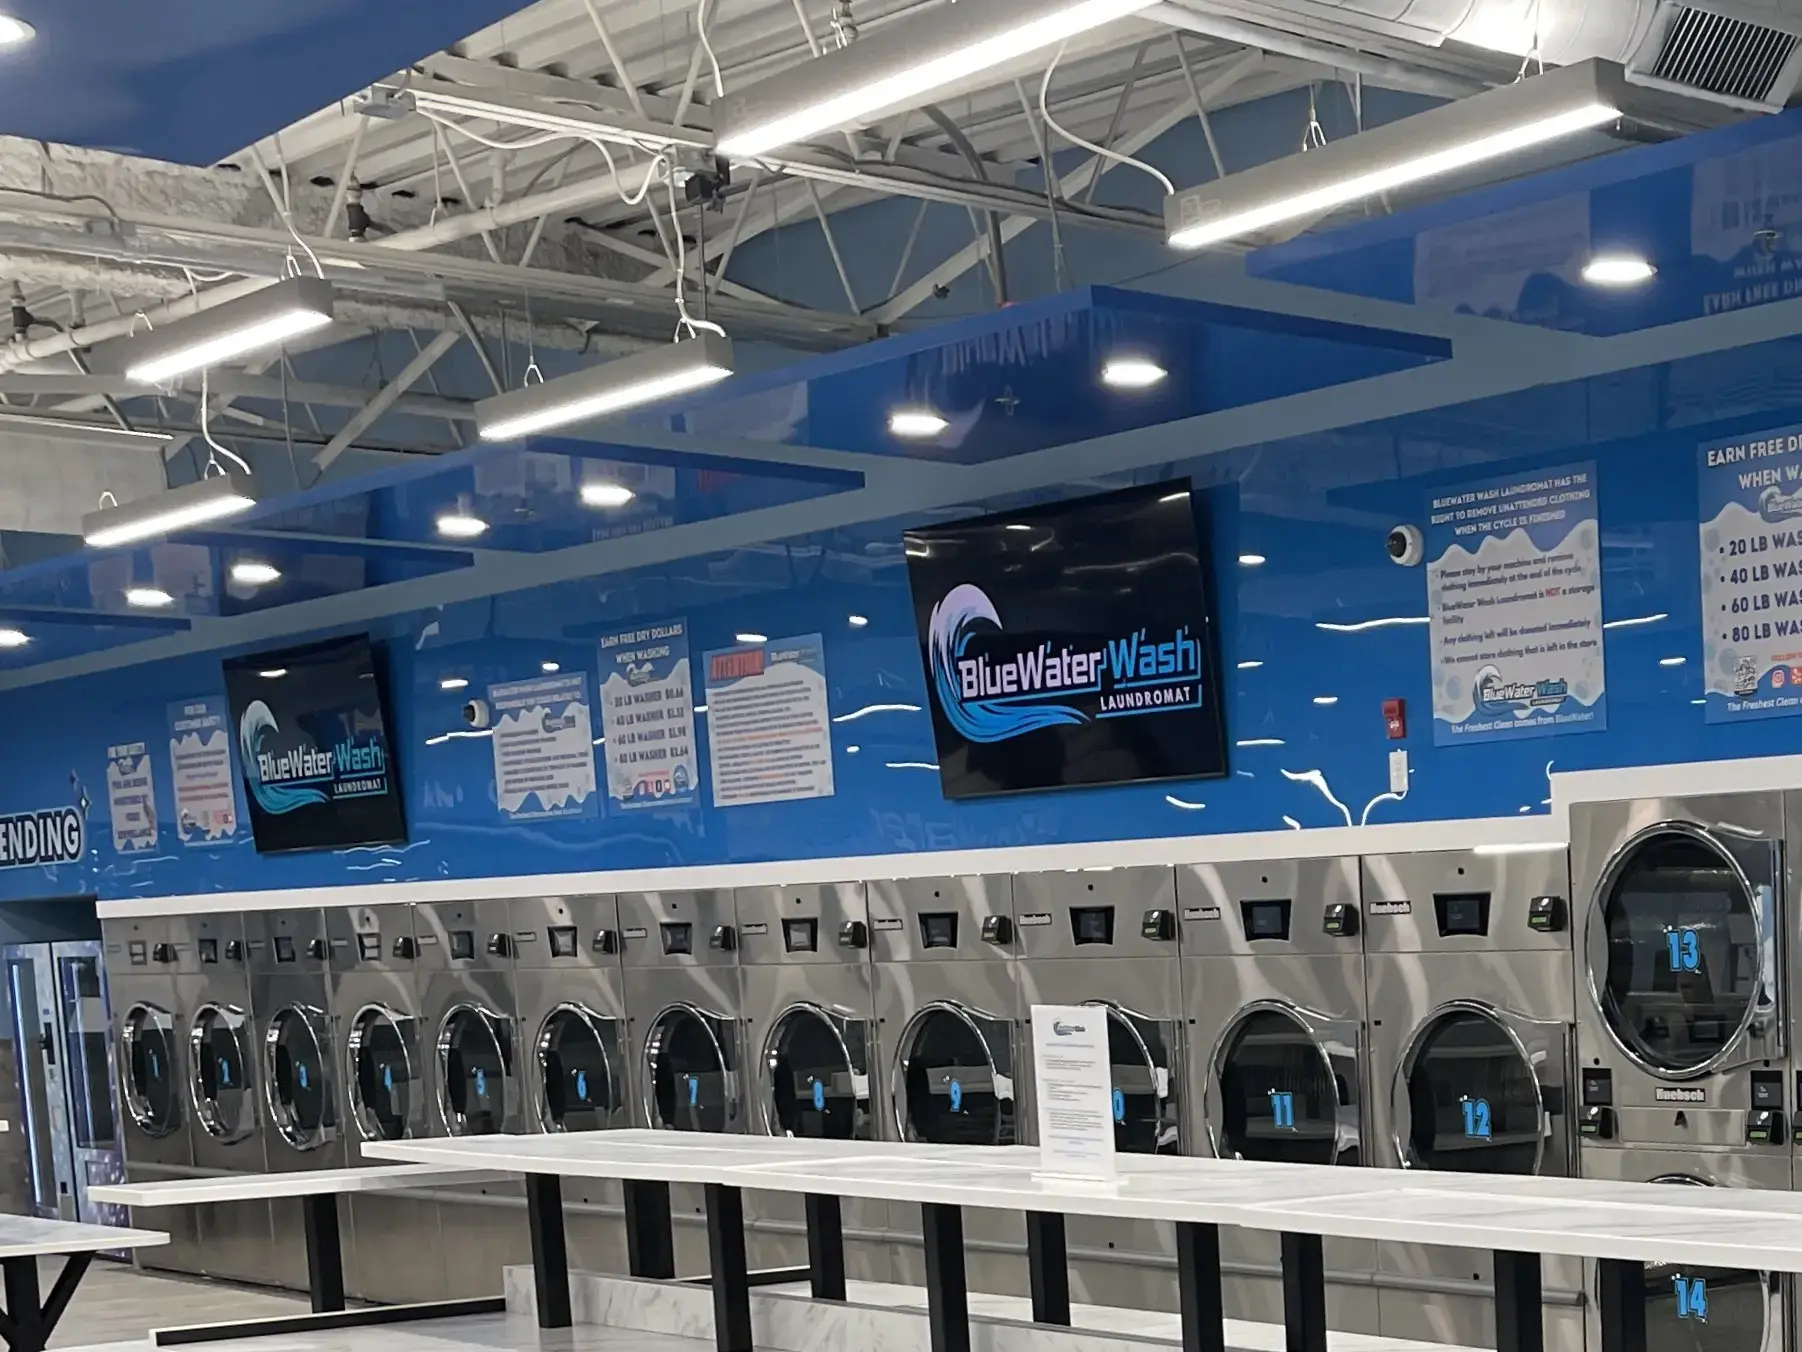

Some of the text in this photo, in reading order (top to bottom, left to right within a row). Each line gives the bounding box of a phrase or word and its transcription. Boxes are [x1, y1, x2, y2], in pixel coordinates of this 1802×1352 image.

[1707, 446, 1745, 466] EARN
[1750, 438, 1784, 459] FREE
[1433, 473, 1588, 509] BLUEWATER WASH LAUNDROMAT HAS THE
[1739, 470, 1781, 490] WHEN
[1456, 510, 1465, 520] TO
[1467, 506, 1497, 519] REMOVE
[1455, 524, 1477, 537] WHEN
[1479, 521, 1492, 532] THE
[1494, 518, 1517, 530] CYCLE
[1729, 539, 1745, 556] 20
[1751, 536, 1768, 553] LB
[1730, 568, 1748, 584] 40
[1752, 565, 1769, 582] LB
[1731, 597, 1749, 613] 60
[1754, 594, 1770, 611] LB
[1732, 626, 1749, 642] 80
[1755, 623, 1771, 639] LB
[959, 628, 1197, 698] BlueWater Wash
[1101, 686, 1190, 711] LAUNDROMAT
[1483, 683, 1534, 701] BlueWater
[258, 746, 332, 782] BlueWater
[336, 739, 382, 772] Wash
[334, 778, 382, 794] LAUNDROMAT
[1666, 929, 1700, 971] 13
[576, 1070, 588, 1100] 6
[688, 1075, 699, 1107] 7
[812, 1078, 825, 1112] 8
[949, 1078, 964, 1115] 9
[1656, 1088, 1705, 1101] Huebsch
[1270, 1091, 1295, 1129] 11
[1462, 1098, 1492, 1139] 12
[1675, 1277, 1707, 1319] 14
